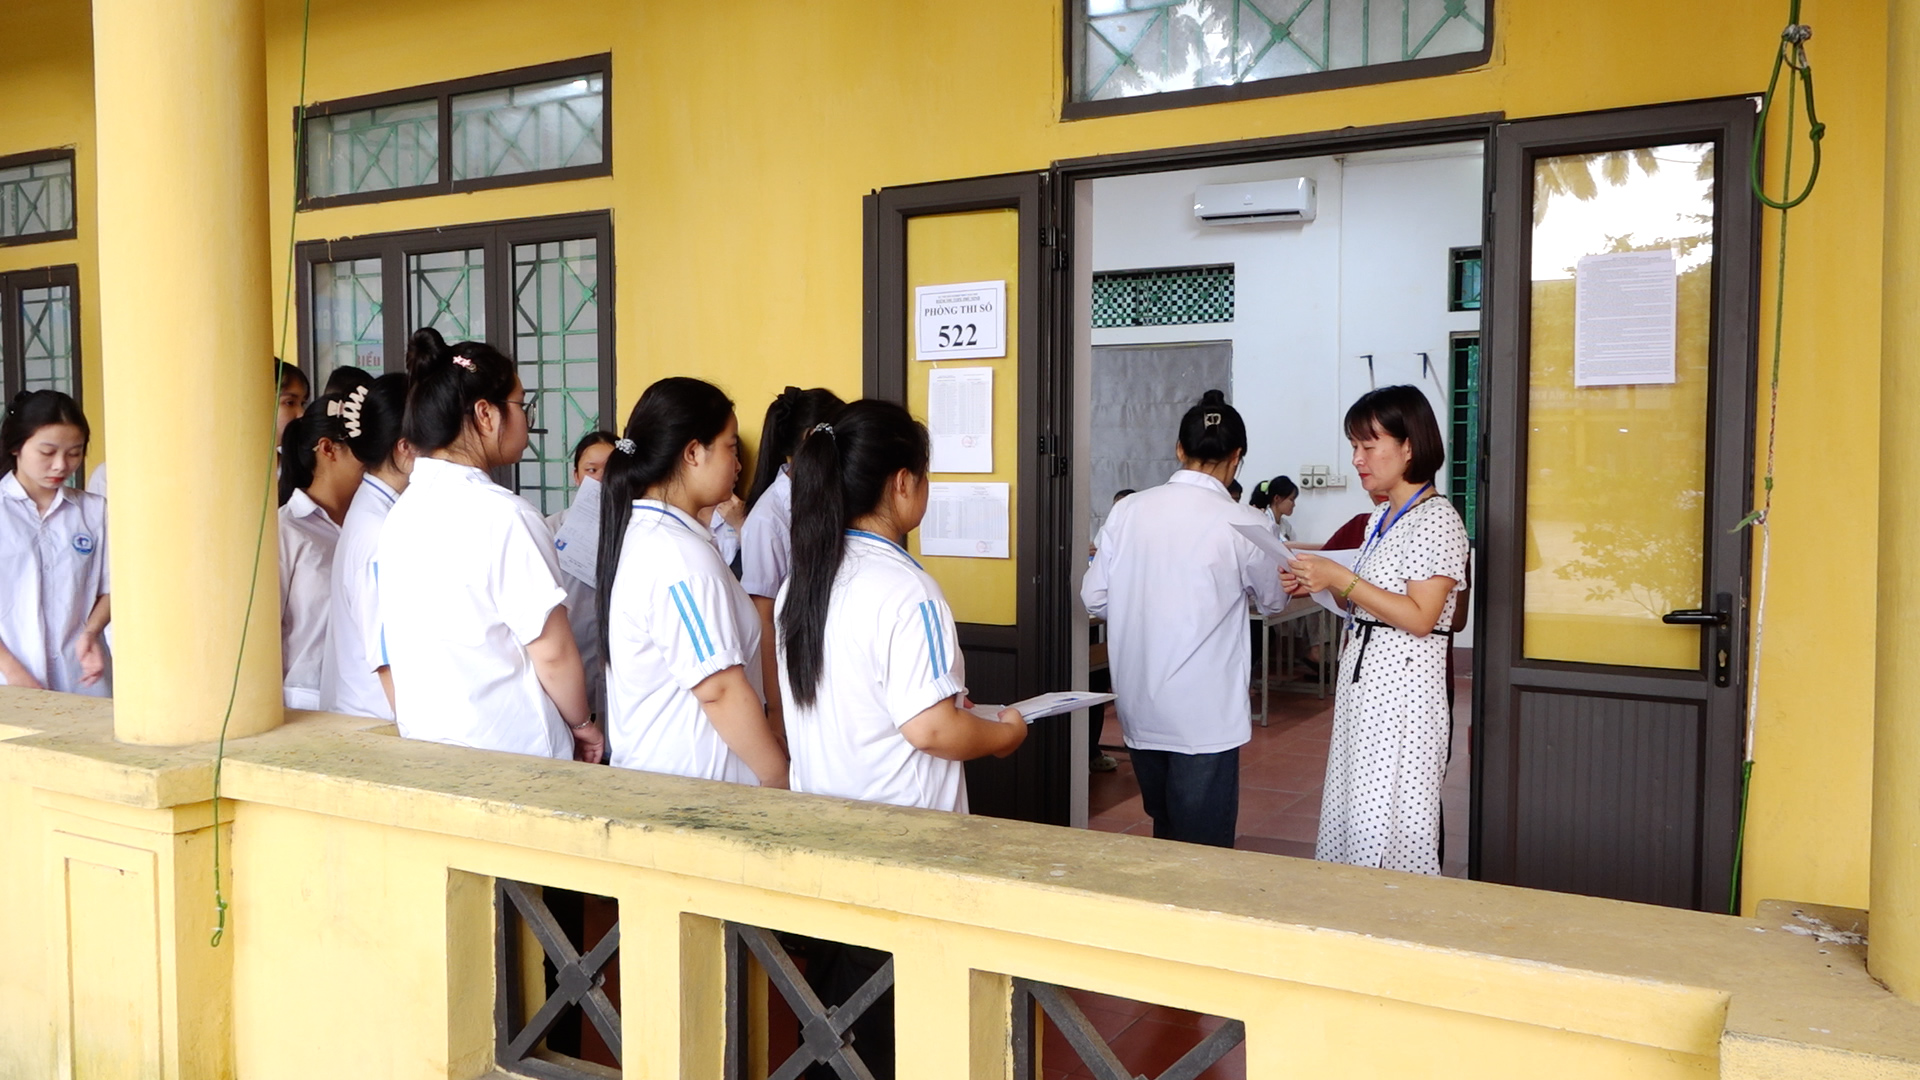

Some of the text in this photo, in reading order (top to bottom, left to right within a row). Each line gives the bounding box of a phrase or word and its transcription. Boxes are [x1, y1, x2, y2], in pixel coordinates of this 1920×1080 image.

[924, 301, 993, 317] PHÒNG THI SỐ
[938, 323, 978, 348] 522
